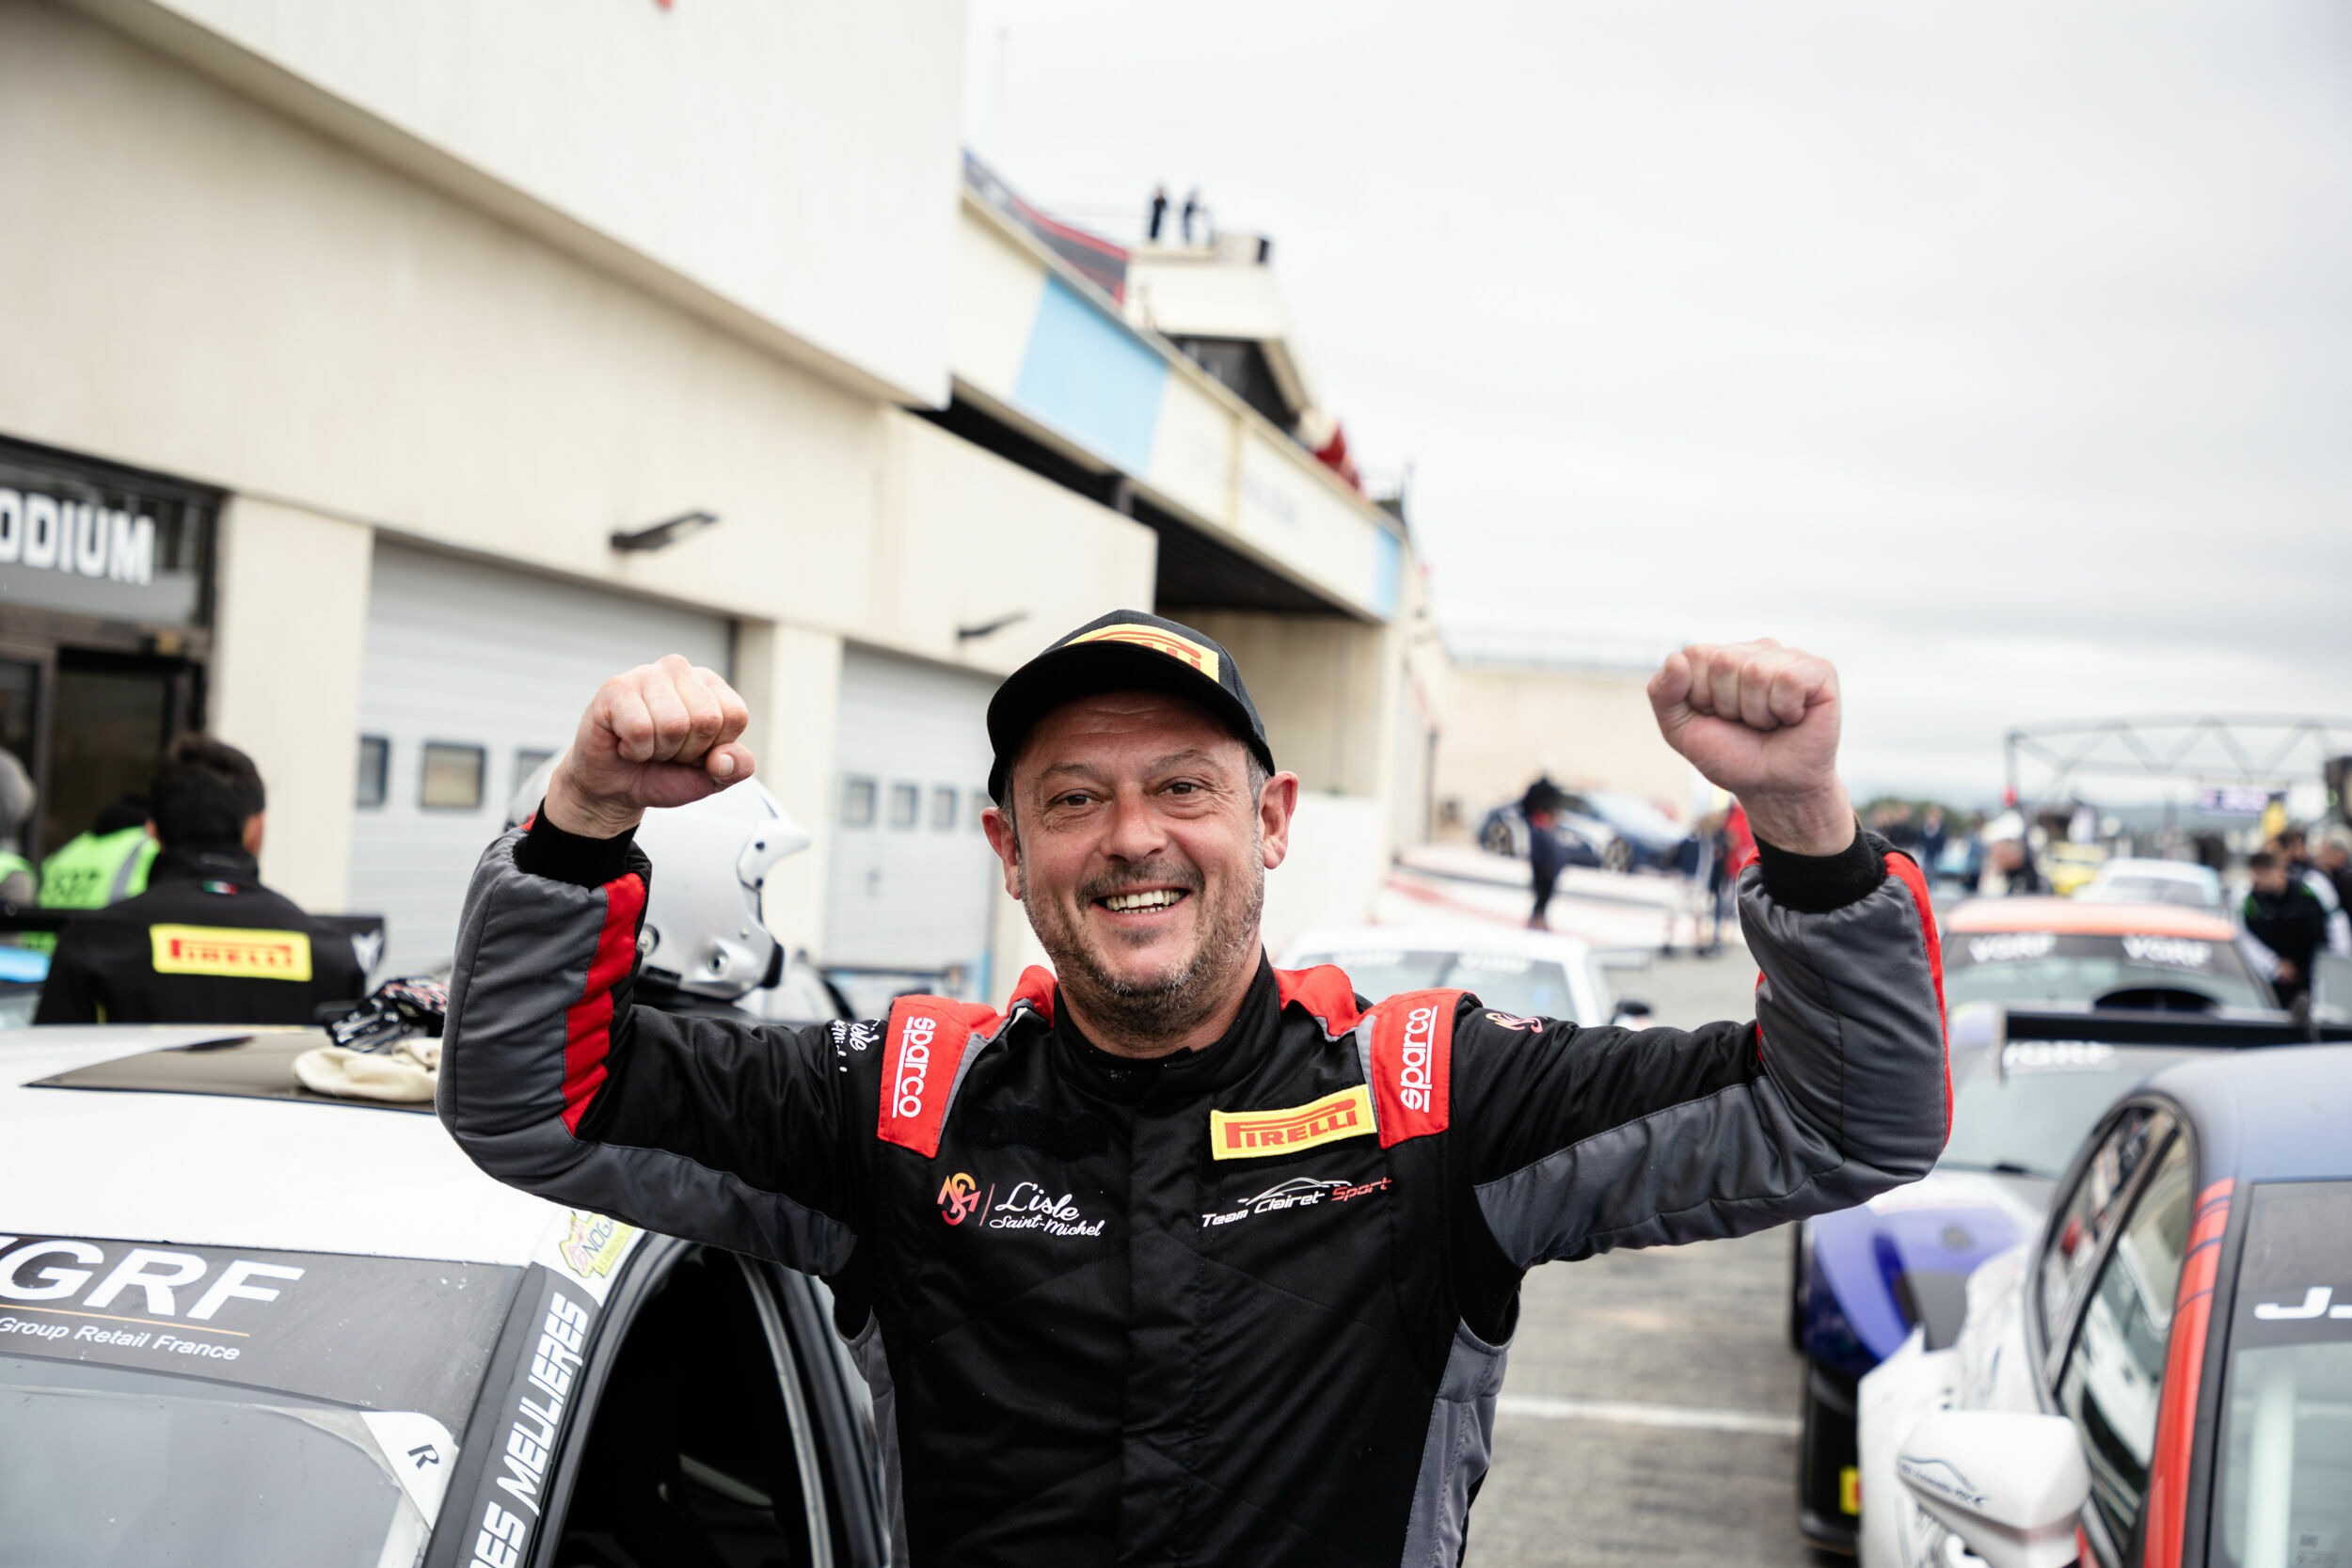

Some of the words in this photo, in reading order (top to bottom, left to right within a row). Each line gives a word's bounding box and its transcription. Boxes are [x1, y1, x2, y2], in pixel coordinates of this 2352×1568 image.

[169, 938, 293, 966] PIRELLI
[898, 1017, 937, 1118] sparco
[1400, 1007, 1433, 1111] sparco
[1224, 1098, 1359, 1149] PIRELLI
[989, 1214, 1105, 1237] Saint-Michel
[1201, 1209, 1249, 1227] Team
[1254, 1191, 1326, 1214] Clairet
[1330, 1177, 1392, 1202] Sport
[0, 1317, 70, 1341] Group
[74, 1324, 151, 1349] Retail
[151, 1334, 241, 1361] France
[496, 1291, 589, 1517] MEULIERES
[469, 1500, 527, 1568] ES
